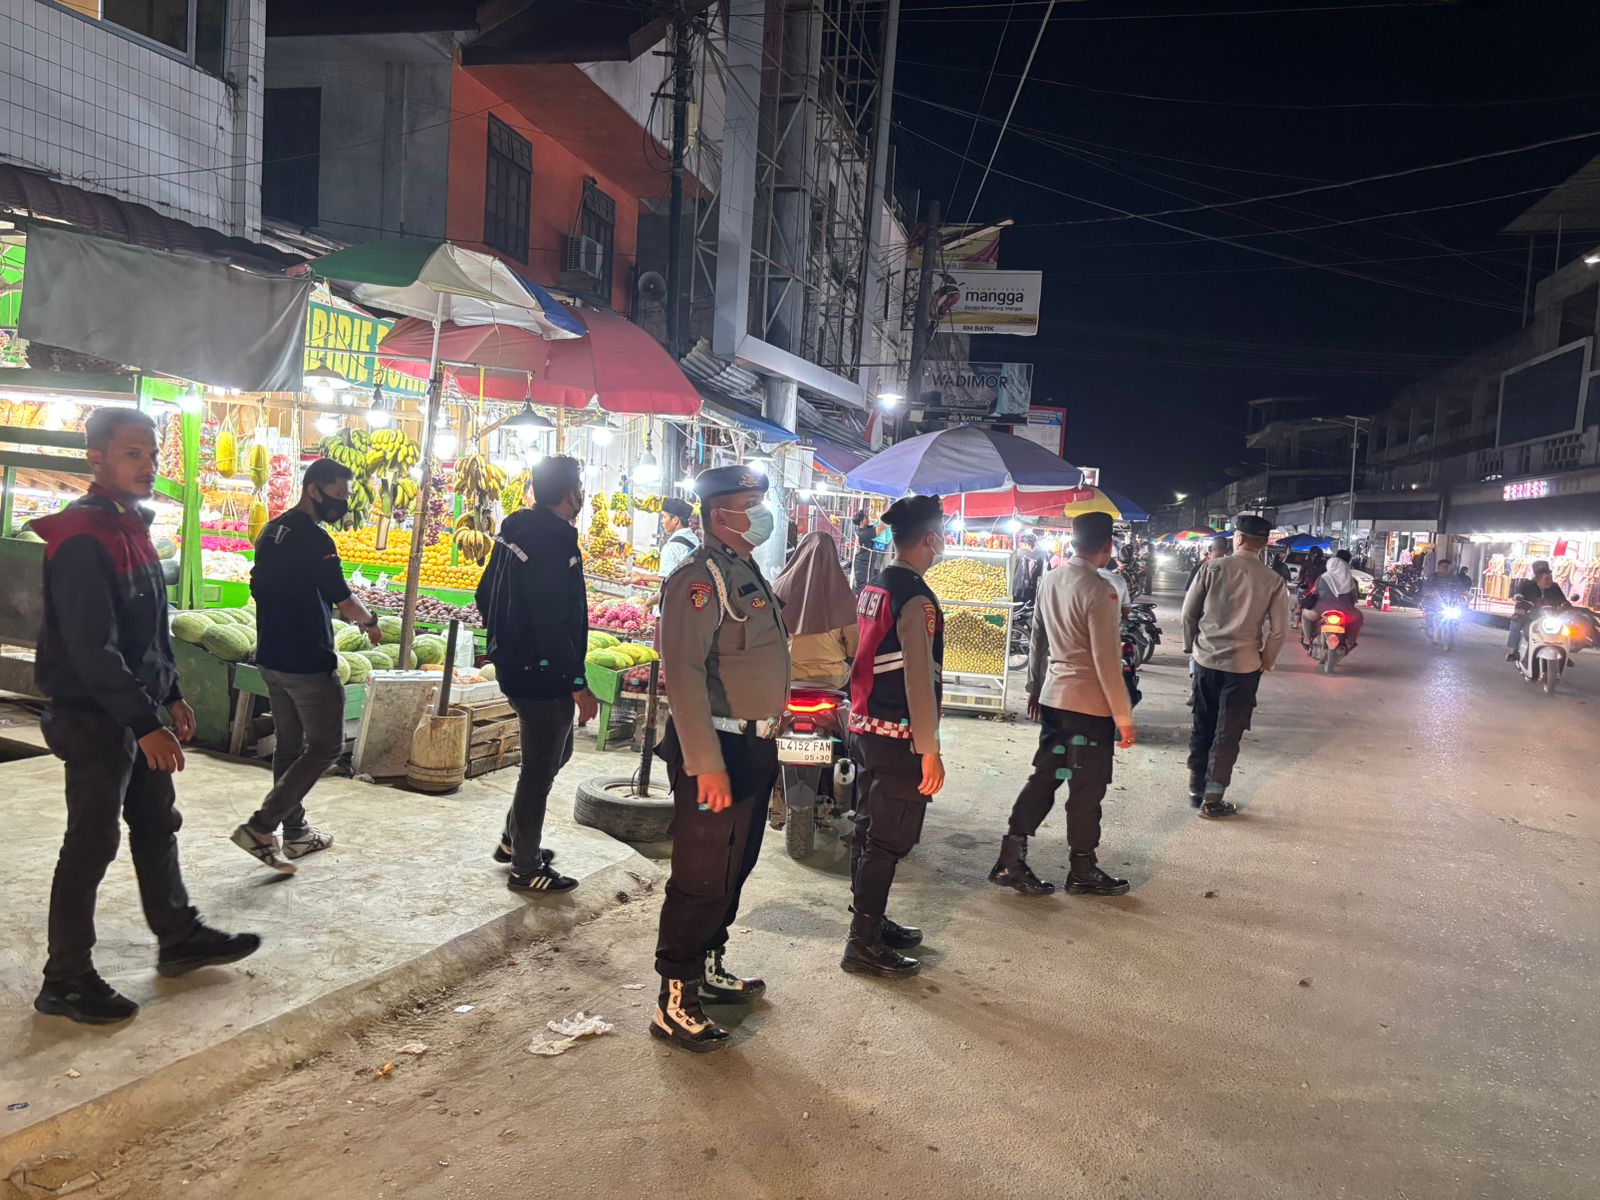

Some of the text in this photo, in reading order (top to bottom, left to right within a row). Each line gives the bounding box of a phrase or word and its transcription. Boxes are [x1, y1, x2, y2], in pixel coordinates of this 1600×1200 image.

[965, 291, 1024, 306] mangga
[932, 374, 1009, 389] WADIMOR
[786, 740, 810, 751] 4152
[813, 741, 831, 752] FAN
